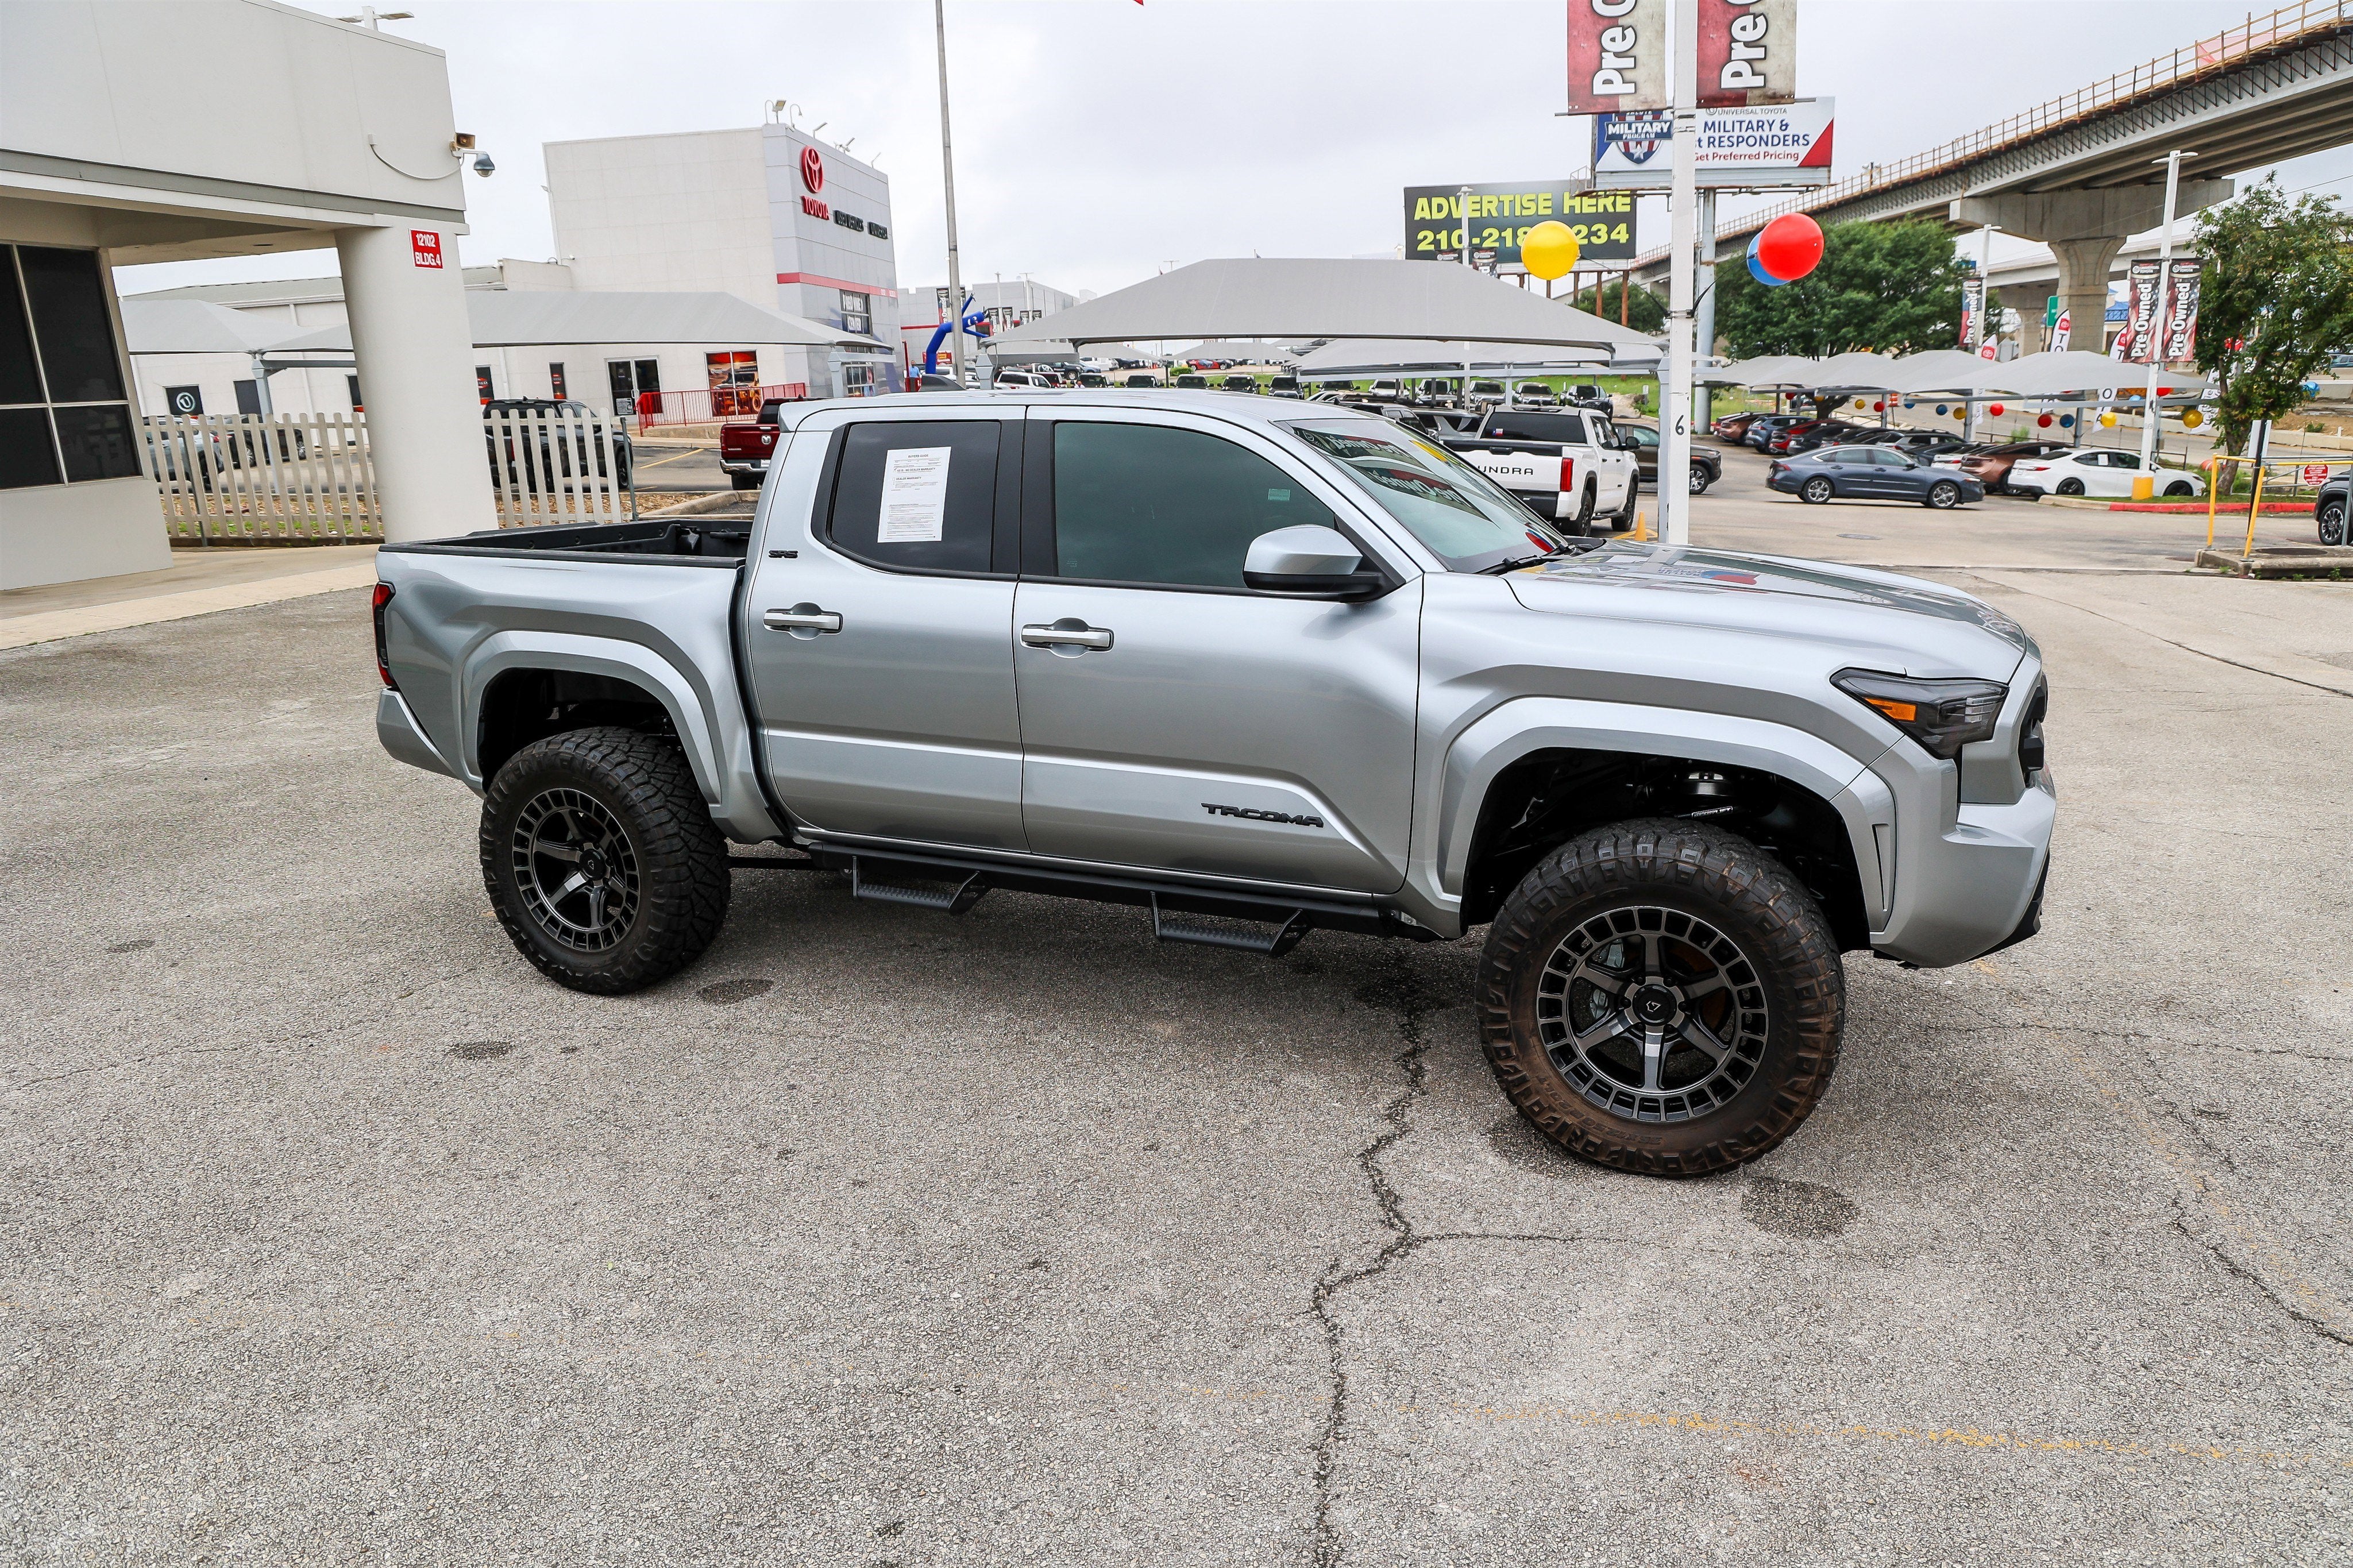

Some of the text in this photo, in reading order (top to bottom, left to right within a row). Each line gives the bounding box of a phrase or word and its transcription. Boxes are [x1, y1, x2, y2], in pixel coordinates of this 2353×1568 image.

[1592, 25, 1636, 95] Pre
[1721, 13, 1767, 88] Pre
[1608, 121, 1670, 135] MILITARY
[1703, 118, 1791, 133] MILITARY &
[1708, 133, 1810, 148] RESPONDERS
[1712, 150, 1760, 161] Preferred
[1764, 150, 1799, 161] Pricing
[800, 195, 830, 220] TOYOTA
[1414, 190, 1631, 221] ADVERTISE HERE
[415, 233, 436, 248] 12102
[2135, 283, 2152, 331] Owned
[2168, 283, 2190, 357] Pre Owned
[2131, 334, 2147, 357] Pre
[1675, 415, 1684, 435] 6
[768, 550, 799, 559] SR5
[1201, 802, 1324, 828] TACOMA
